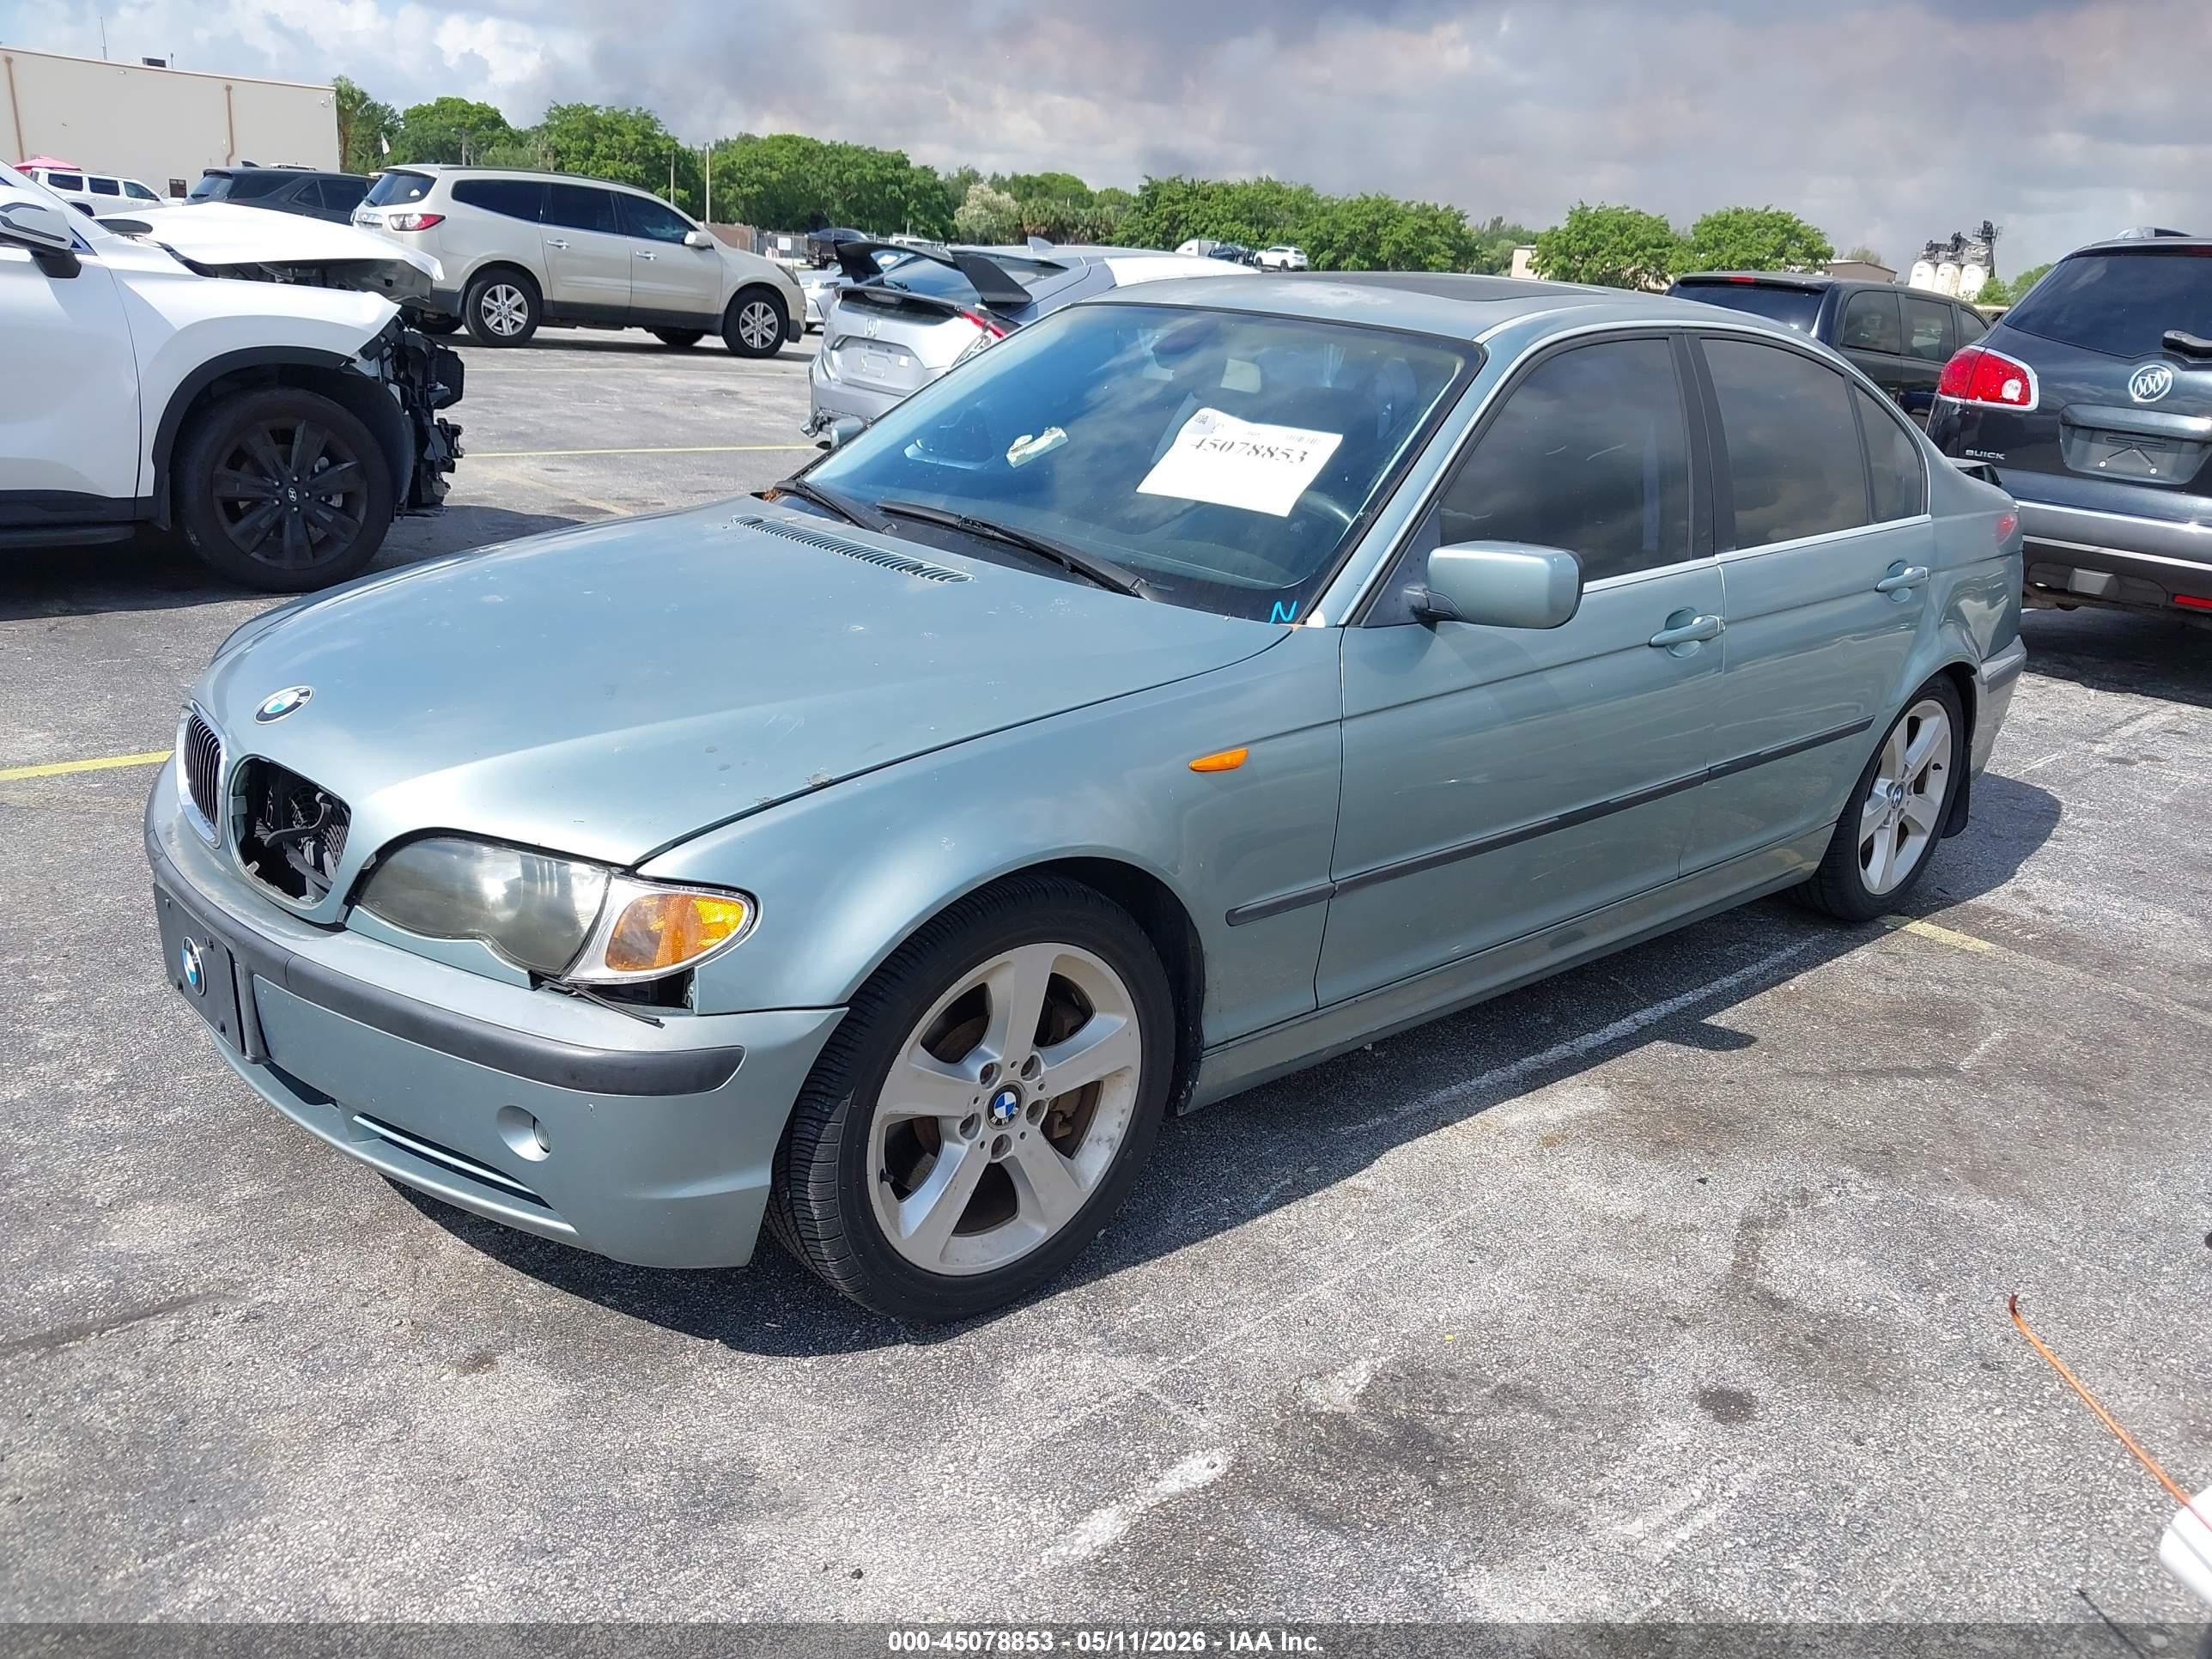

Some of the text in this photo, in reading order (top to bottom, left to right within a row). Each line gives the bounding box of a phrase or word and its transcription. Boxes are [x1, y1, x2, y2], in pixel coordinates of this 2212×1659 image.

[1191, 437, 1309, 464] 45078853
[1965, 449, 2006, 460] BUICK
[1270, 600, 1297, 624] N
